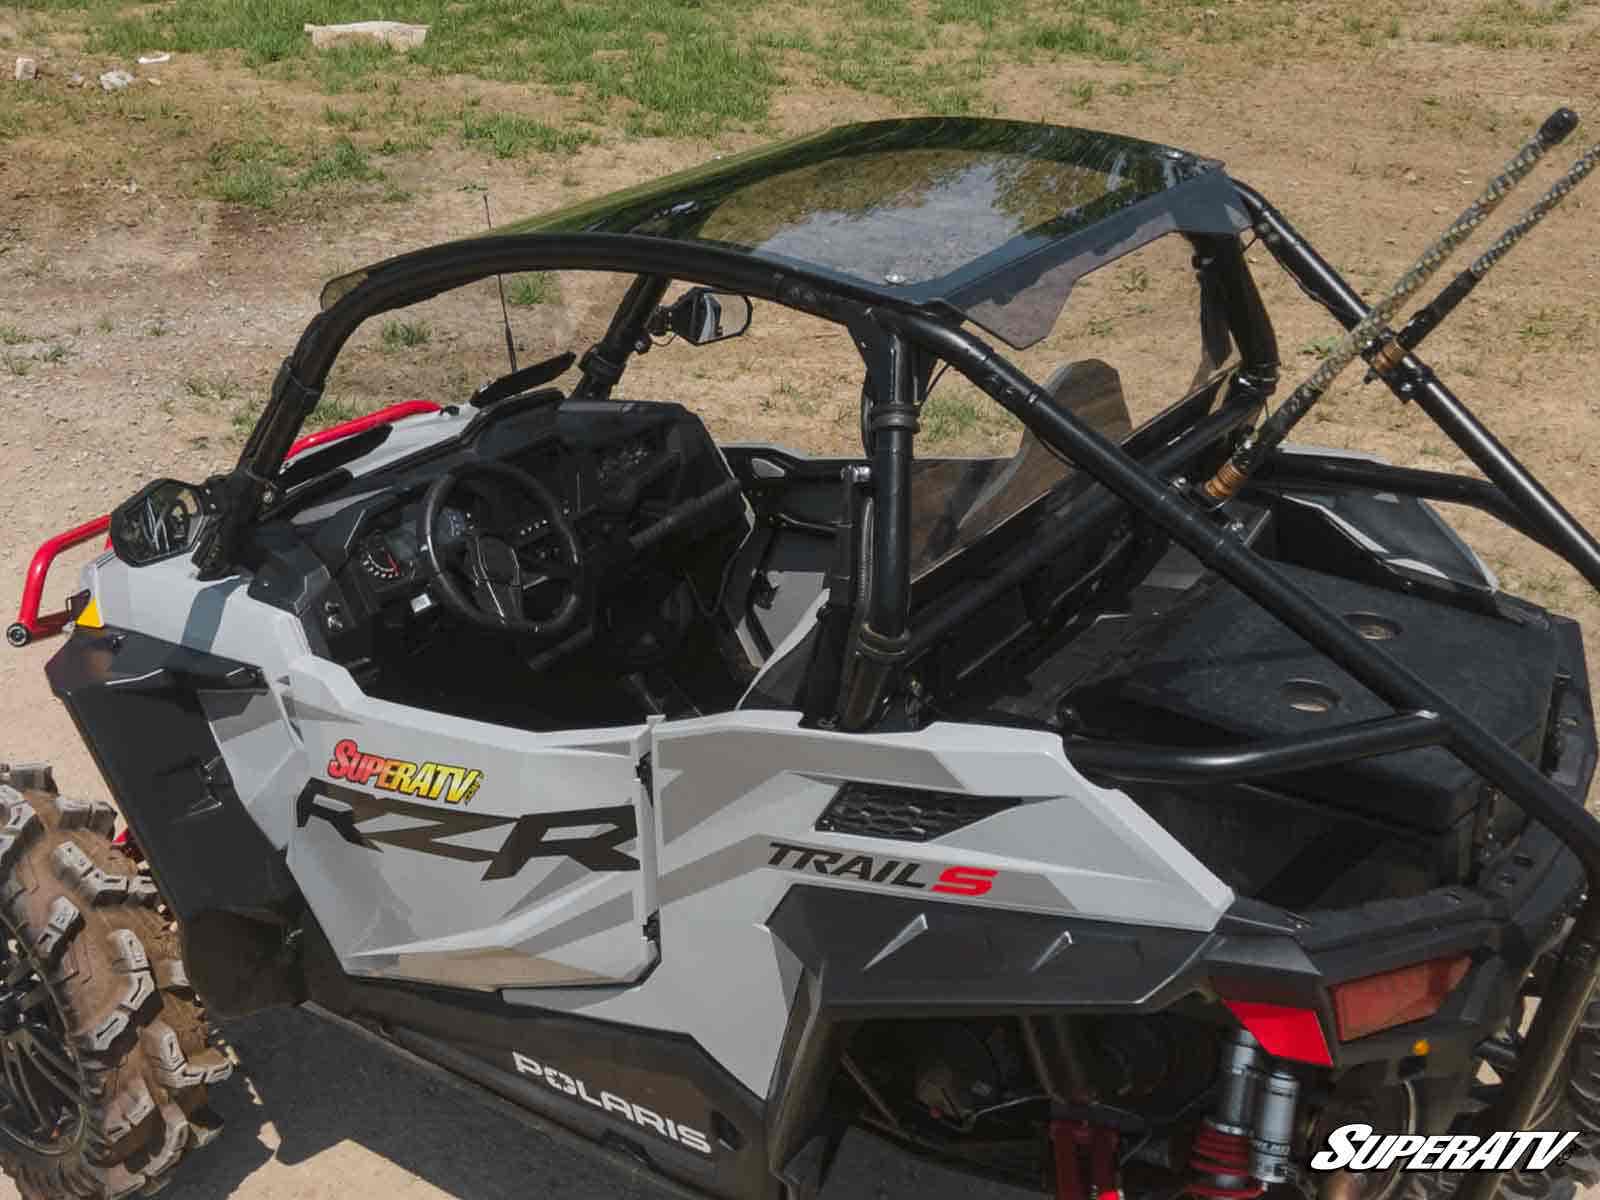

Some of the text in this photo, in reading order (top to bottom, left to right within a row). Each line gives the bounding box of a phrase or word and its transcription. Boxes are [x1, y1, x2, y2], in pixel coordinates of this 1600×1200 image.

[296, 777, 641, 881] RZR
[767, 842, 999, 896] TRAIL S
[512, 1051, 712, 1153] POLARIS
